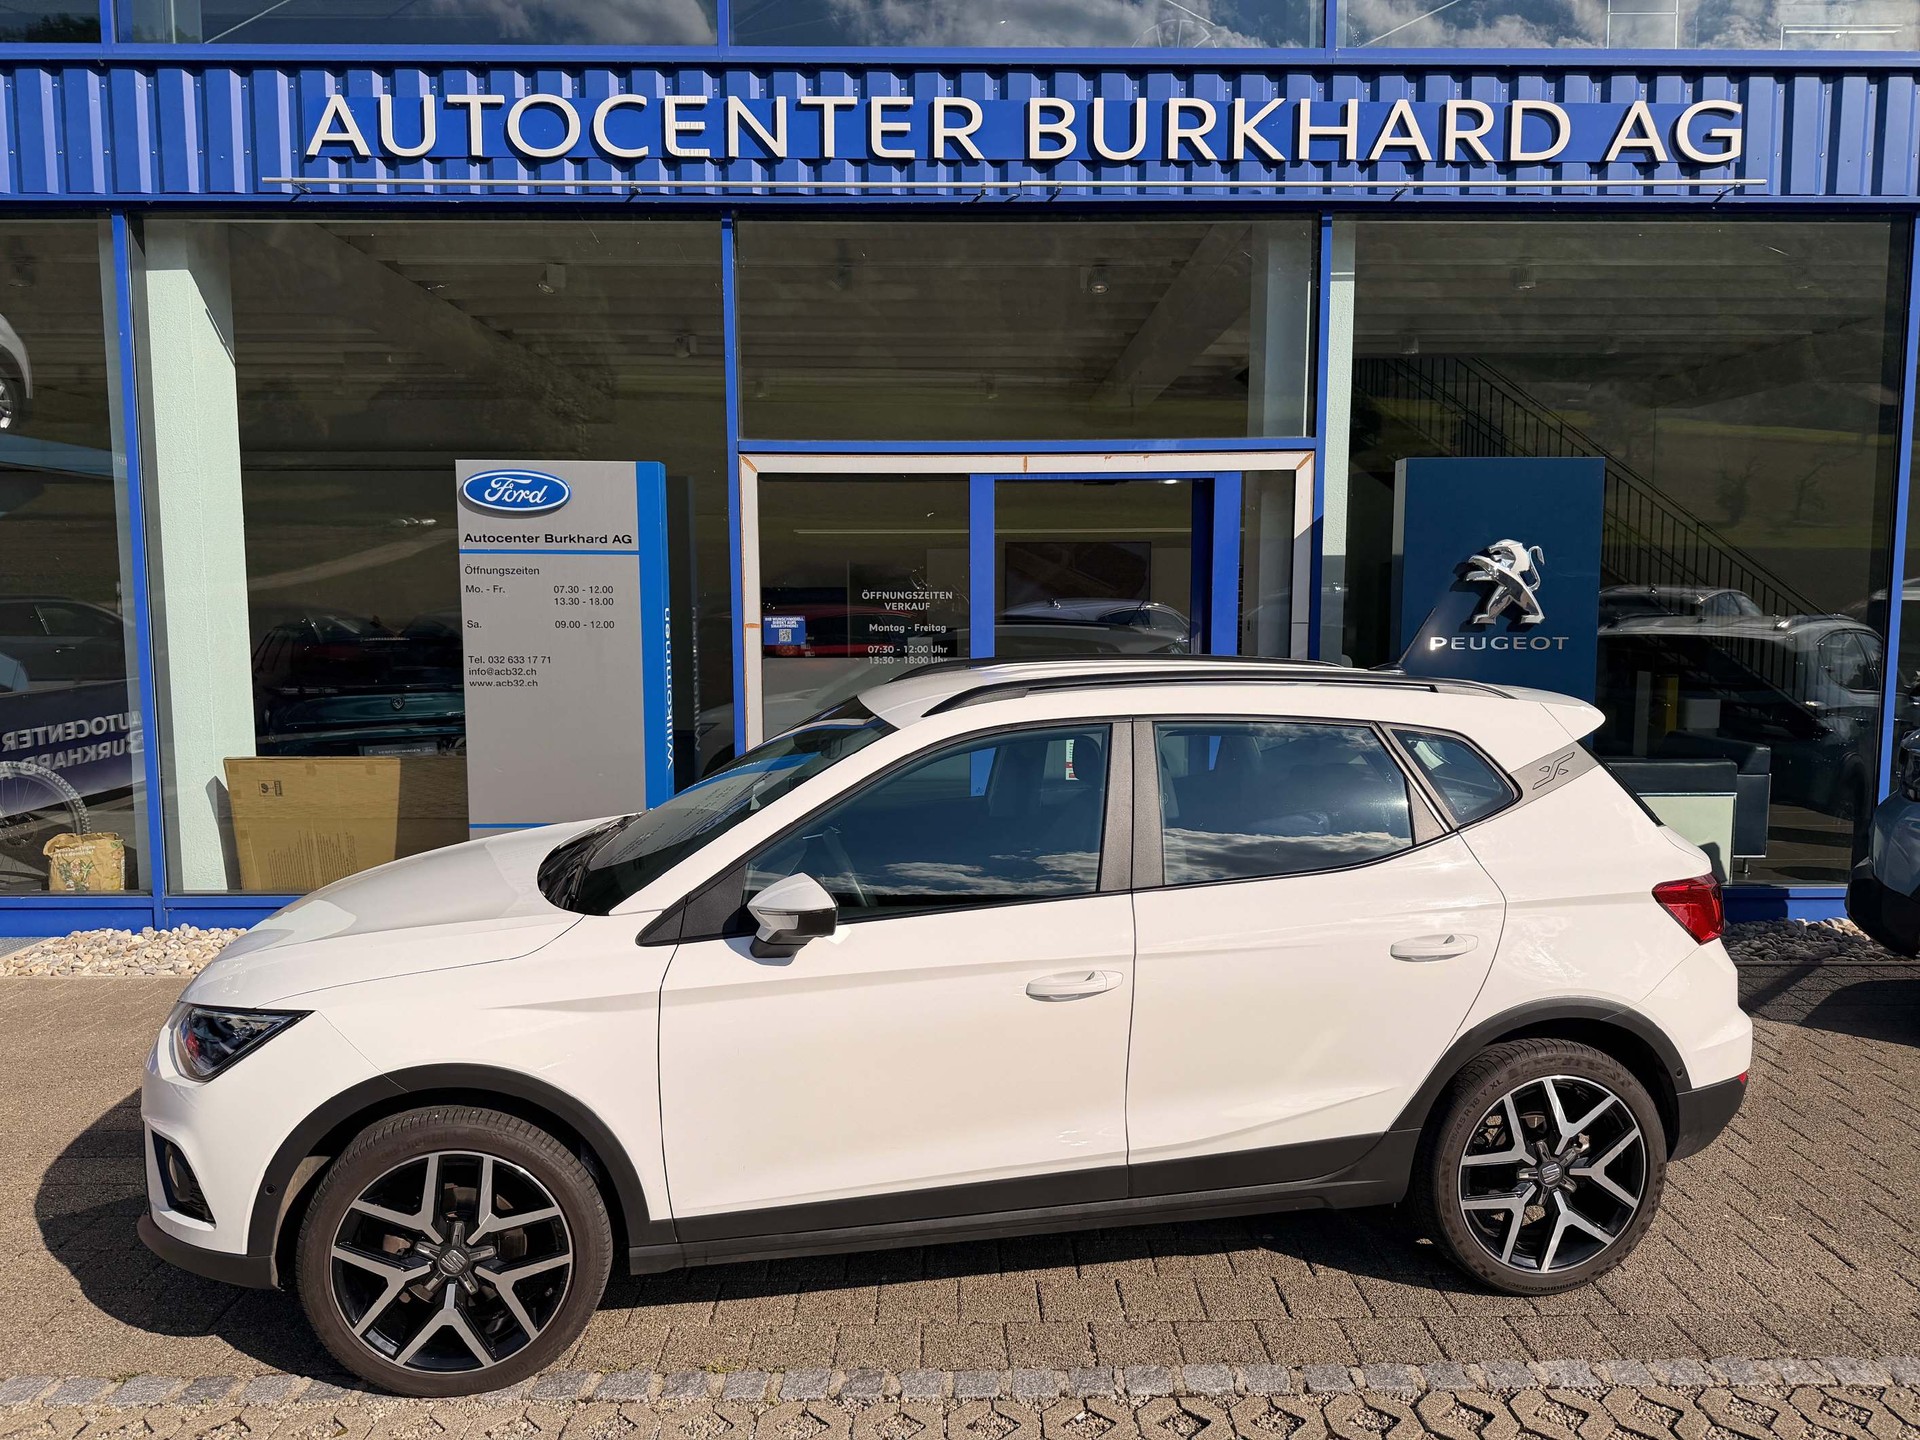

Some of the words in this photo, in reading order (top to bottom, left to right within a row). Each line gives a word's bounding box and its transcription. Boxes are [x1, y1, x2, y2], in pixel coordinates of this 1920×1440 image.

[306, 94, 985, 160] AUTOCENTER
[1029, 97, 1571, 162] BURKHARD
[1605, 99, 1743, 164] AG
[484, 476, 547, 504] Ford
[463, 533, 541, 545] Autocenter
[544, 533, 608, 545] Burkhard
[611, 534, 633, 545] AG
[464, 563, 541, 577] Öffnungszeiten
[465, 584, 484, 594] Mo.
[493, 584, 506, 594] Fr.
[553, 585, 580, 595] 07.30
[589, 585, 614, 595] 12.00
[861, 589, 953, 600] ÖFFNUNGSZEITEN
[554, 597, 580, 607] 13.30
[589, 597, 615, 607] 18.00
[884, 602, 931, 611] VERKAUF
[466, 619, 482, 630] Sa.
[554, 620, 581, 630] 09.00
[590, 620, 615, 630] 12.00
[869, 623, 905, 634] Montag
[914, 623, 947, 634] Freitag
[1430, 636, 1570, 651] PEUGEOT
[867, 645, 895, 654] 07:30
[903, 645, 929, 654] 12:00
[930, 645, 948, 654] Uhr
[467, 655, 486, 665] Tel.
[487, 655, 506, 665] 032
[507, 655, 526, 665] 633
[527, 655, 539, 665] 17
[540, 655, 551, 665] 71
[868, 656, 895, 665] 13:30
[903, 656, 929, 665] 18:00
[468, 666, 537, 677] info@acb32.ch
[468, 679, 539, 688] www.acb32.ch
[664, 607, 674, 770] Willkommen
